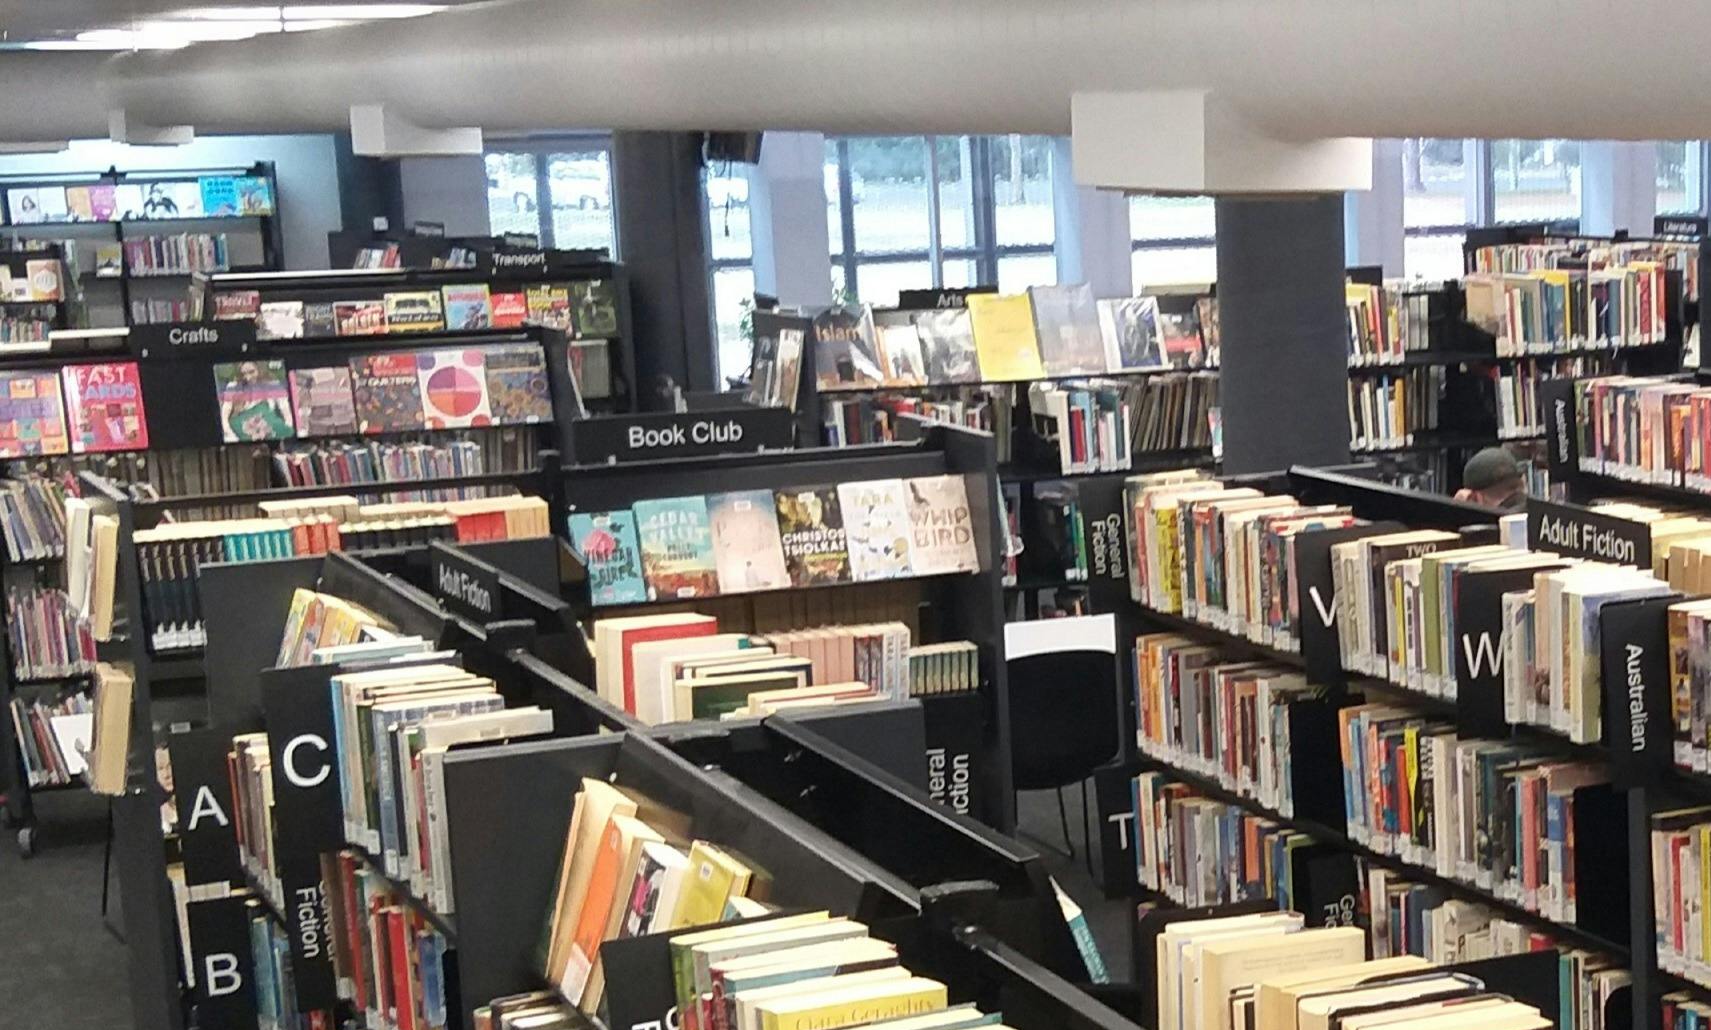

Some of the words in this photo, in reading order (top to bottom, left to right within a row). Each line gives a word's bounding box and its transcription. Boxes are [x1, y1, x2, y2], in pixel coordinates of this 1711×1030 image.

[492, 252, 546, 268] Transport
[169, 327, 219, 345] Crafts
[815, 324, 862, 342] Islam
[76, 366, 127, 386] FAST
[629, 426, 686, 449] Book
[692, 420, 743, 444] Club
[911, 505, 969, 527] WHIP
[913, 527, 971, 548] BIRD
[1540, 515, 1579, 547] Adult
[1582, 524, 1636, 562] Fiction
[1091, 519, 1107, 576] Fiction
[1106, 513, 1125, 579] General
[438, 562, 462, 600] Adult
[461, 573, 492, 614] Fiction
[1309, 586, 1336, 628] V
[1462, 631, 1503, 679] W
[1624, 642, 1648, 752] Australian
[282, 733, 331, 787] C
[187, 785, 230, 832] A
[1108, 812, 1135, 850] T
[296, 886, 320, 959] Fiction
[205, 952, 243, 997] B
